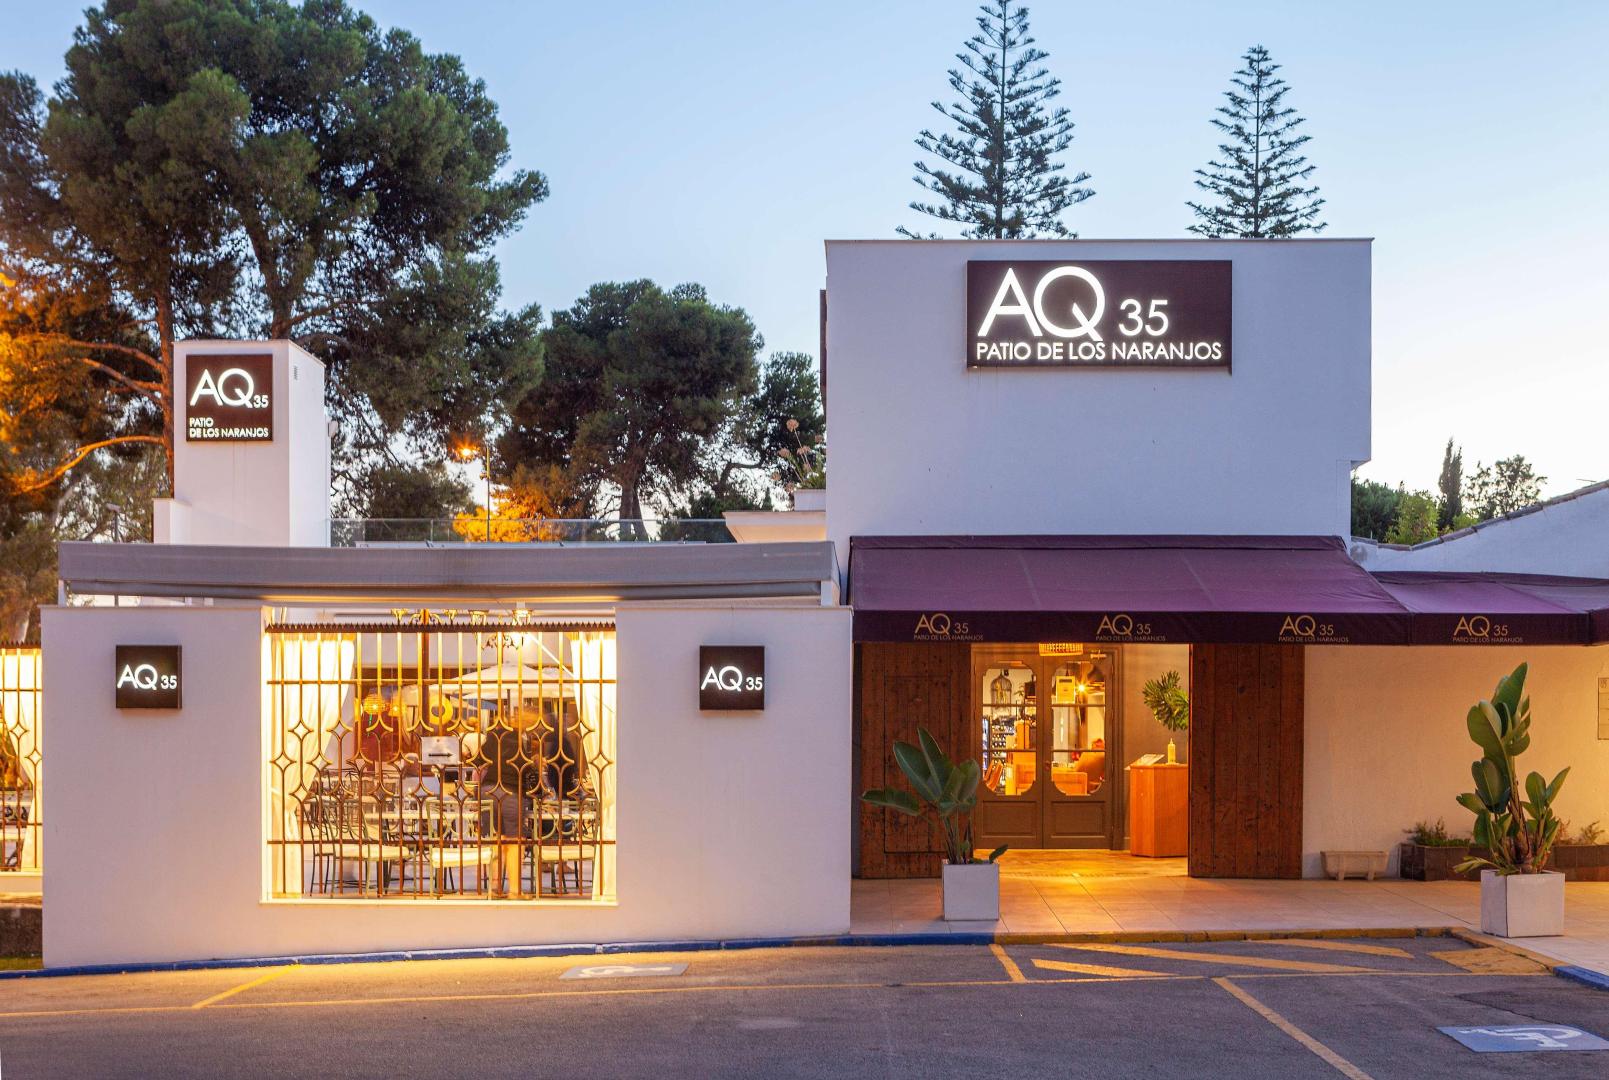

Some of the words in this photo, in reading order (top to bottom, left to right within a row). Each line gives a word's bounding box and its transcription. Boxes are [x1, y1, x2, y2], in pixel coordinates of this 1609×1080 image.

[977, 266, 1105, 341] AQ
[1118, 299, 1169, 336] 35
[976, 342, 1032, 360] PATIO
[1037, 342, 1064, 360] DE
[1069, 342, 1106, 360] LOS
[1111, 342, 1222, 360] NARANJOS
[189, 368, 254, 408] AQ
[253, 394, 269, 408] 35
[189, 417, 214, 427] PATIO
[189, 427, 202, 438] DE
[202, 427, 220, 438] LOS
[221, 427, 269, 438] NARANJOS
[914, 613, 951, 635] AQ
[954, 622, 969, 634] 35
[1096, 614, 1133, 636] AQ
[1136, 623, 1151, 635] 35
[1279, 615, 1316, 637] AQ
[1319, 624, 1334, 636] 35
[1453, 615, 1490, 637] AQ
[1493, 625, 1508, 636] 35
[117, 664, 158, 690] AQ
[160, 674, 177, 690] 35
[700, 665, 743, 692] AQ
[745, 676, 763, 691] 35
